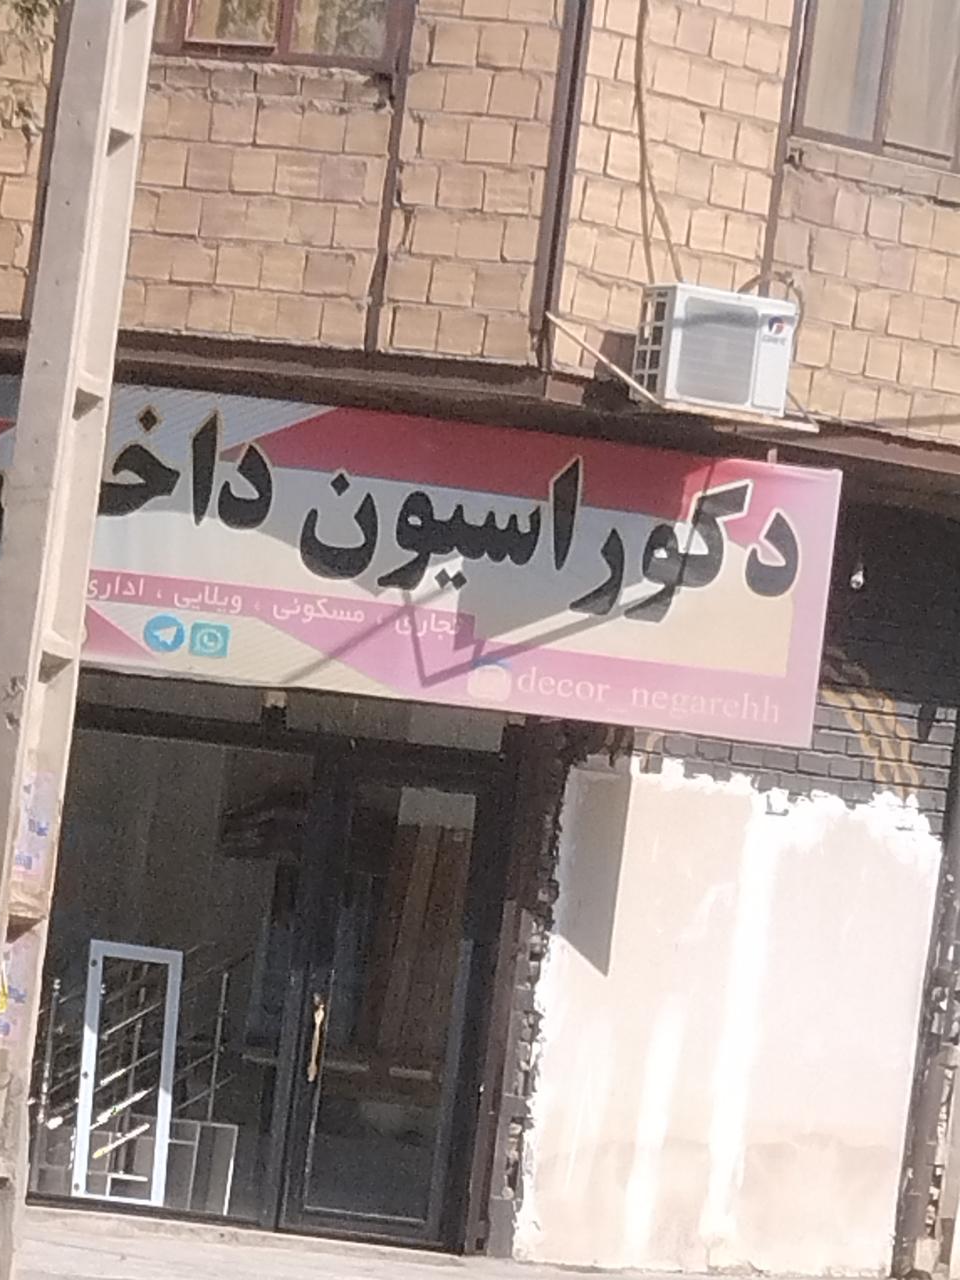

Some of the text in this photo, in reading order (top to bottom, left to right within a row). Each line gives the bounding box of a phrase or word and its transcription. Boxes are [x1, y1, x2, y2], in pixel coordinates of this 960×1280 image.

[299, 456, 799, 624] دکوراسیون
[86, 575, 145, 600] اداری
[272, 597, 365, 625] مسکونی
